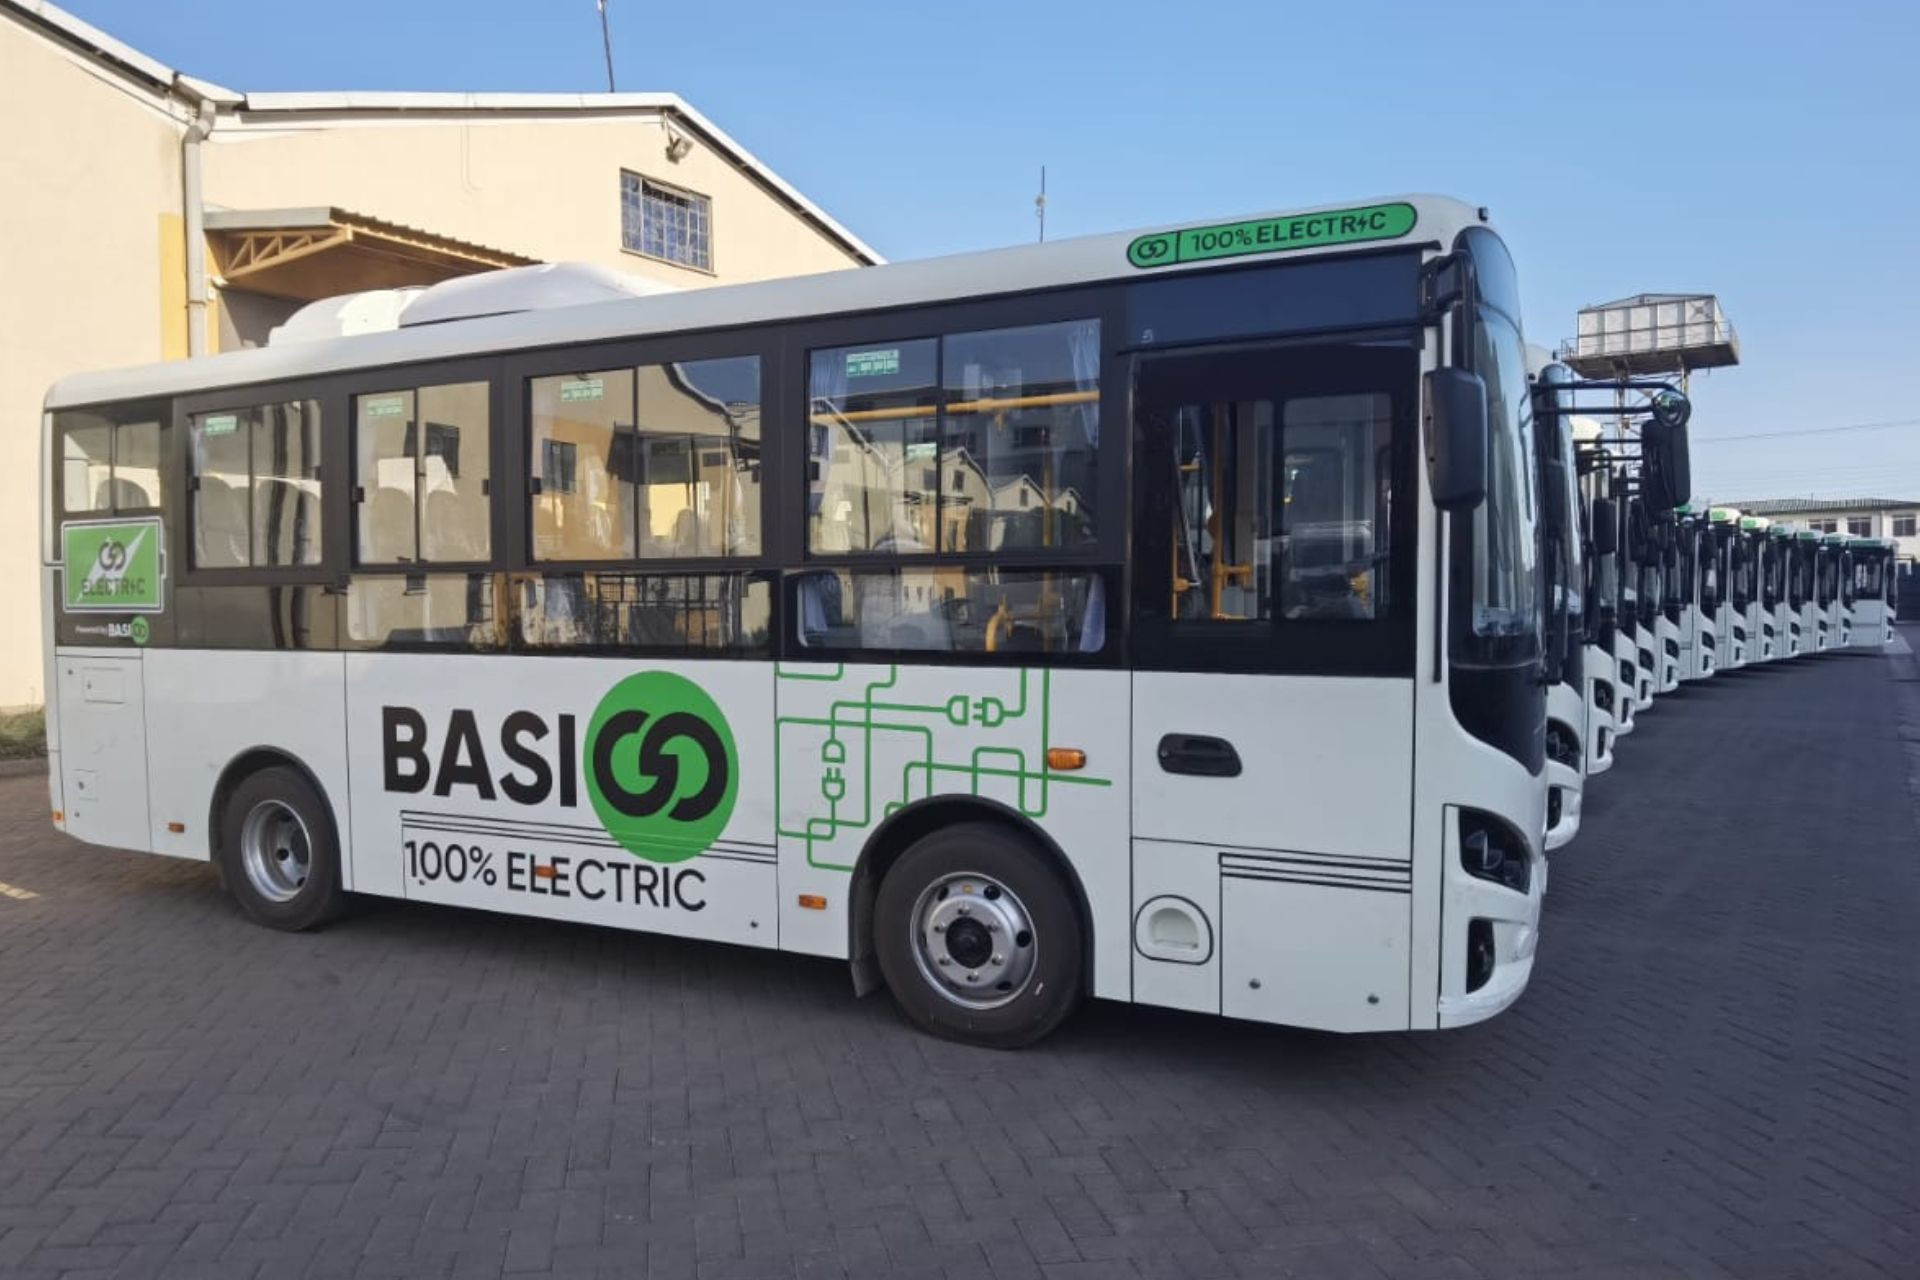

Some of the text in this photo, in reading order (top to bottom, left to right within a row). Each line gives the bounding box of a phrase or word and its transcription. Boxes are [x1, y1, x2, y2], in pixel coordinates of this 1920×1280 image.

[1192, 228, 1252, 252] 100%
[404, 840, 707, 912] 100% ELECTRIC
